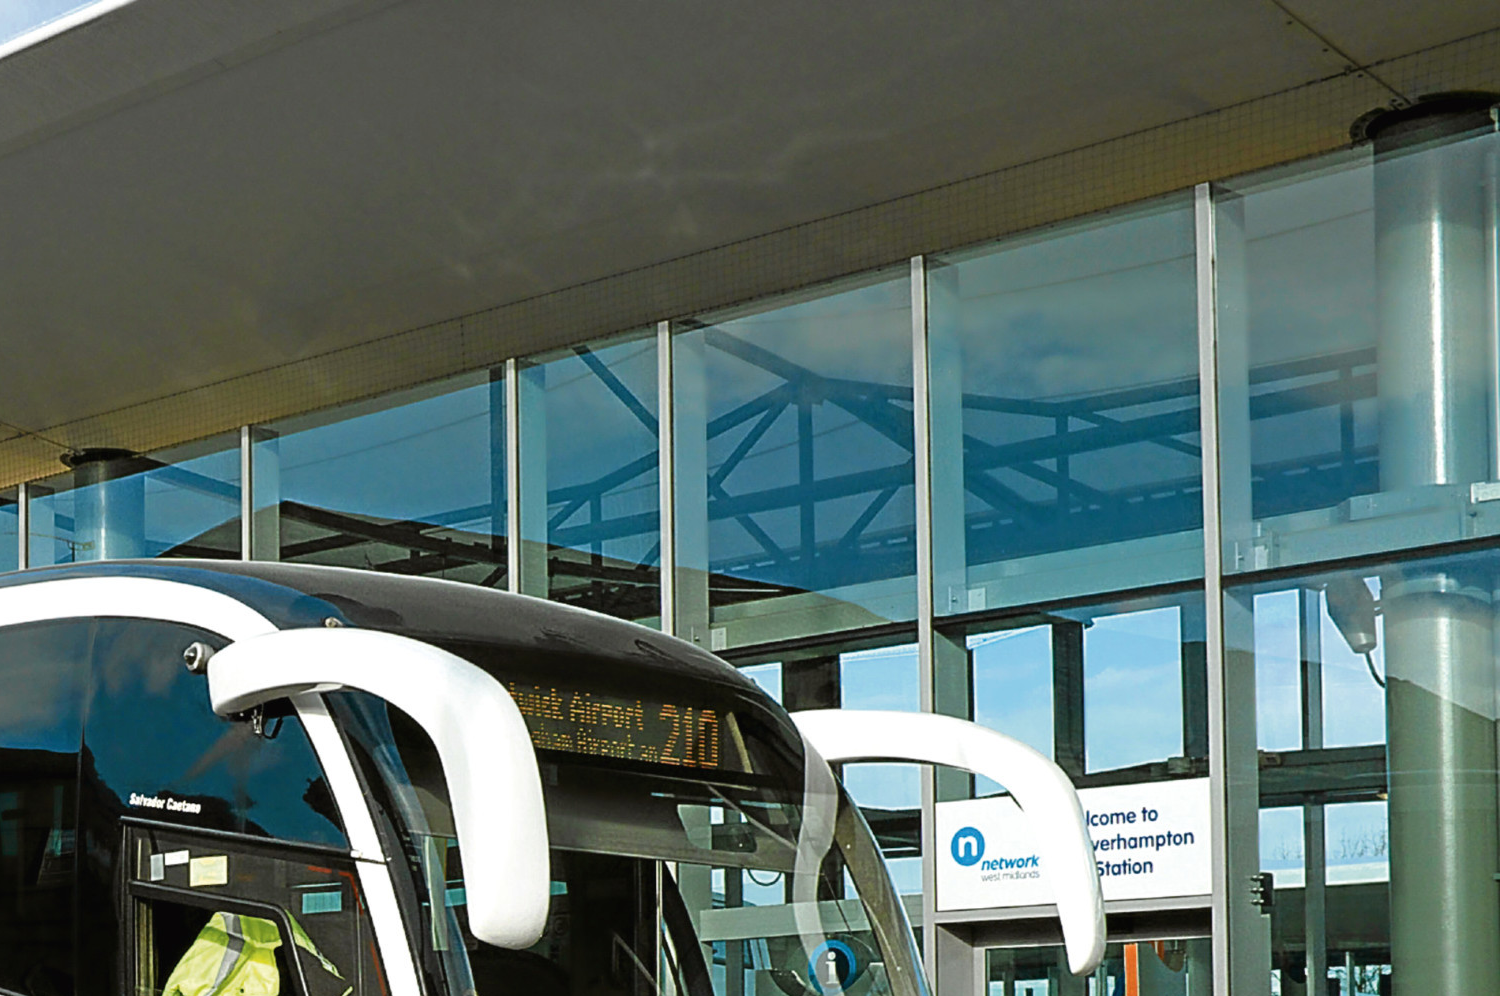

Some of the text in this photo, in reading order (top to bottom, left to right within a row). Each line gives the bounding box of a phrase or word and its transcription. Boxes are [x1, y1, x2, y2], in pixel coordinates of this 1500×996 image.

[569, 691, 644, 731] Airport
[659, 703, 719, 769] 210
[129, 792, 202, 815] Salvador Caetano
[1085, 806, 1159, 827] lcome to
[1090, 830, 1195, 852] verhampton
[980, 854, 1040, 871] network
[981, 870, 1040, 882] west midlands
